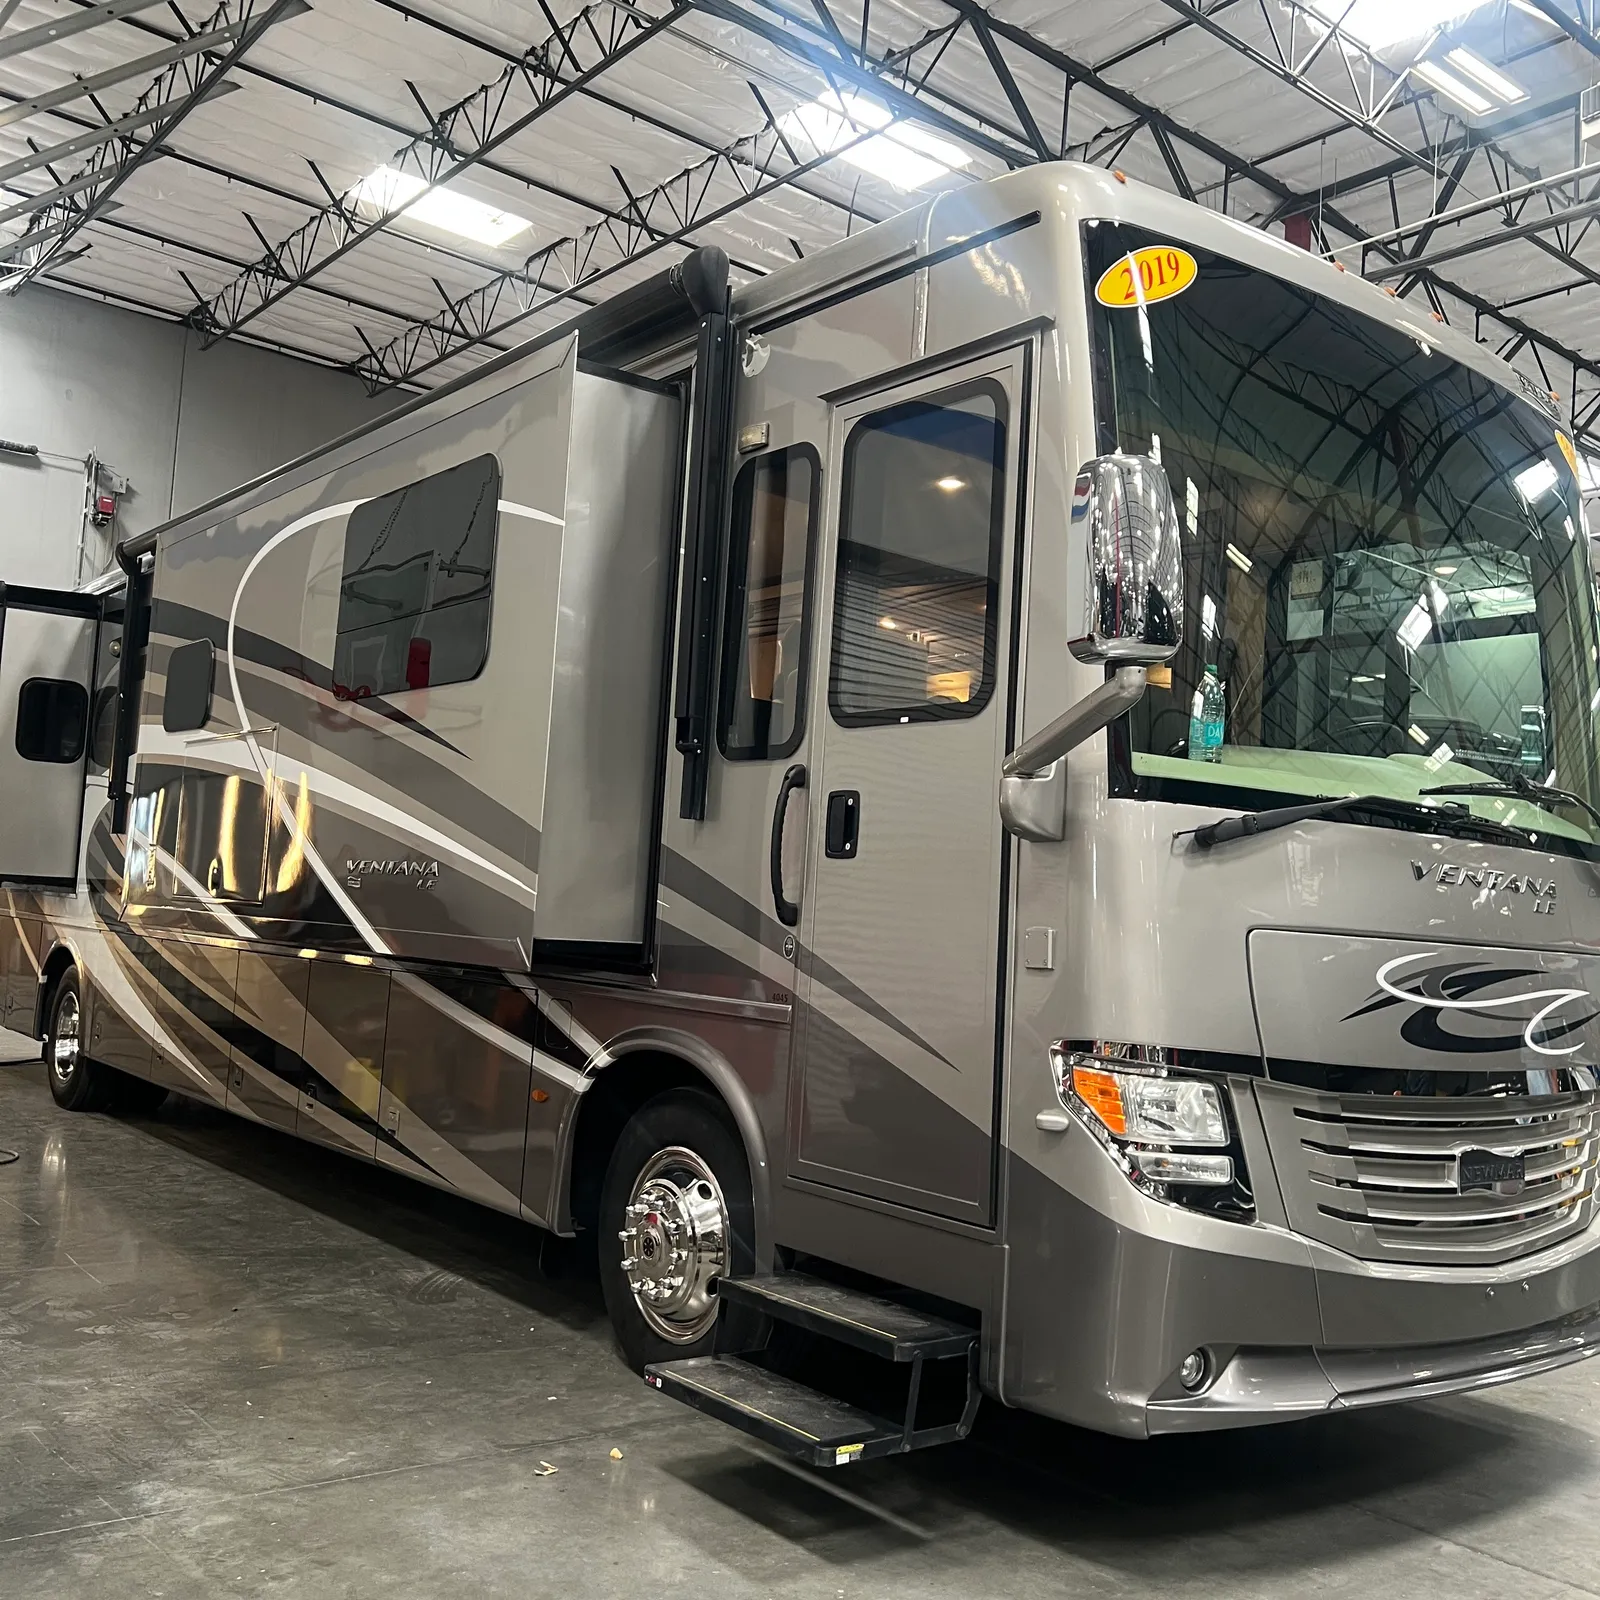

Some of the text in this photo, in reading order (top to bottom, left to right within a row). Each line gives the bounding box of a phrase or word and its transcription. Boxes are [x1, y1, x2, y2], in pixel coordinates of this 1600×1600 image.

[1120, 252, 1179, 300] 2019
[346, 860, 439, 876] VENTANA
[416, 879, 438, 890] LE
[1410, 859, 1557, 899] VENTANA
[1533, 899, 1557, 915] LE
[1461, 1163, 1524, 1183] NEWMAR
